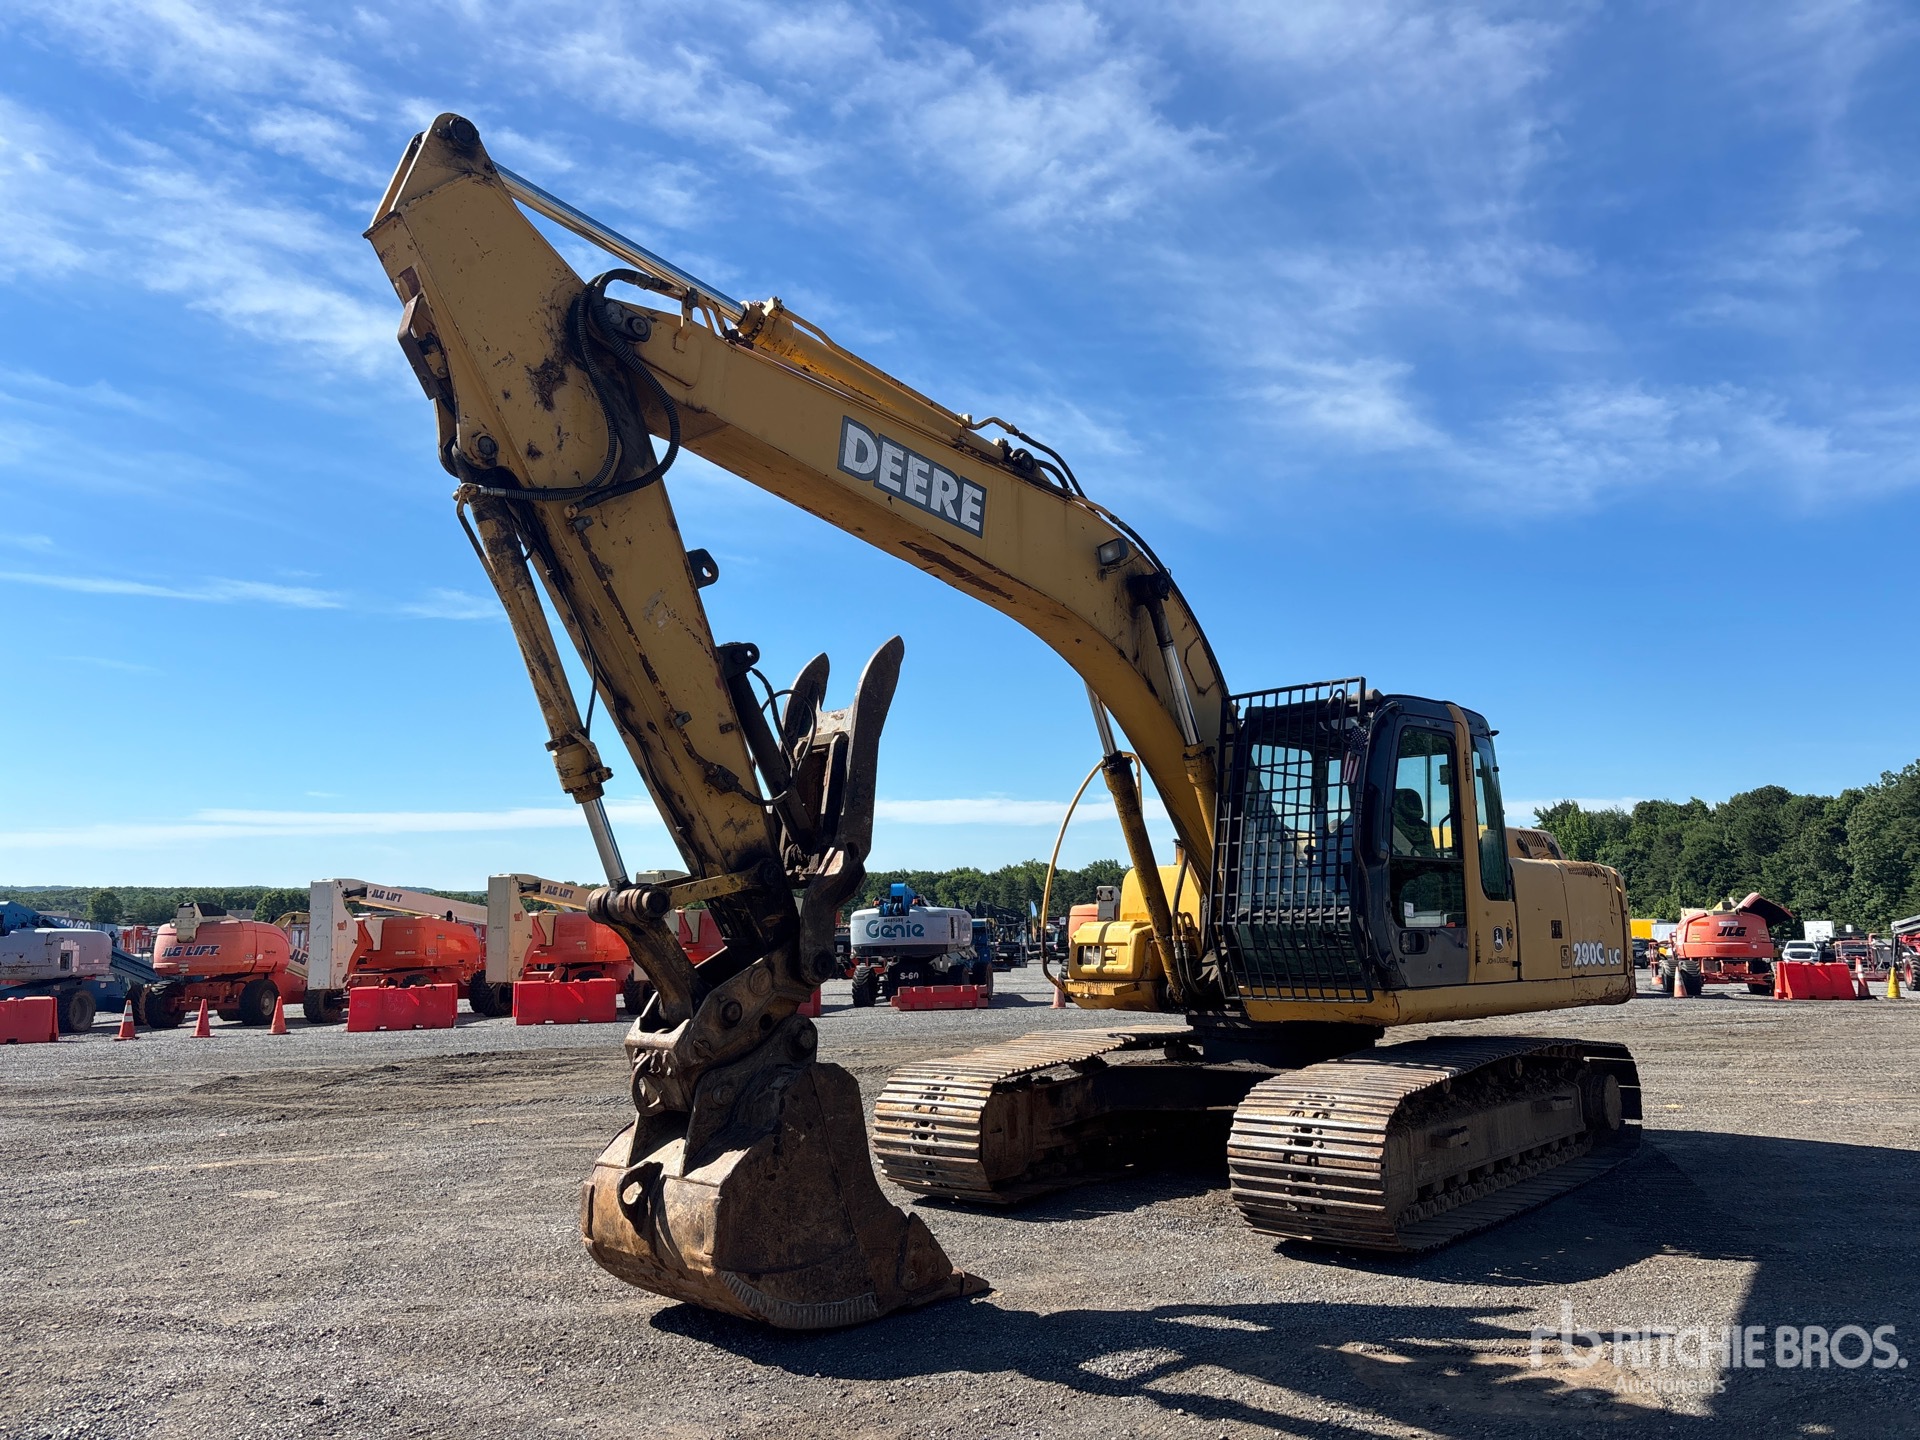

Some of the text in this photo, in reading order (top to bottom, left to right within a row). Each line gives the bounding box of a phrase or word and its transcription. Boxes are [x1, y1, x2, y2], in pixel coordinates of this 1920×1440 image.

[843, 422, 985, 533] DEERE
[371, 888, 403, 903] JLG LIFT
[544, 884, 575, 899] JLG LIFT
[866, 920, 925, 939] Genie
[1717, 926, 1748, 937] JLG
[162, 945, 220, 957] JLG LIFT
[289, 949, 309, 966] JLG
